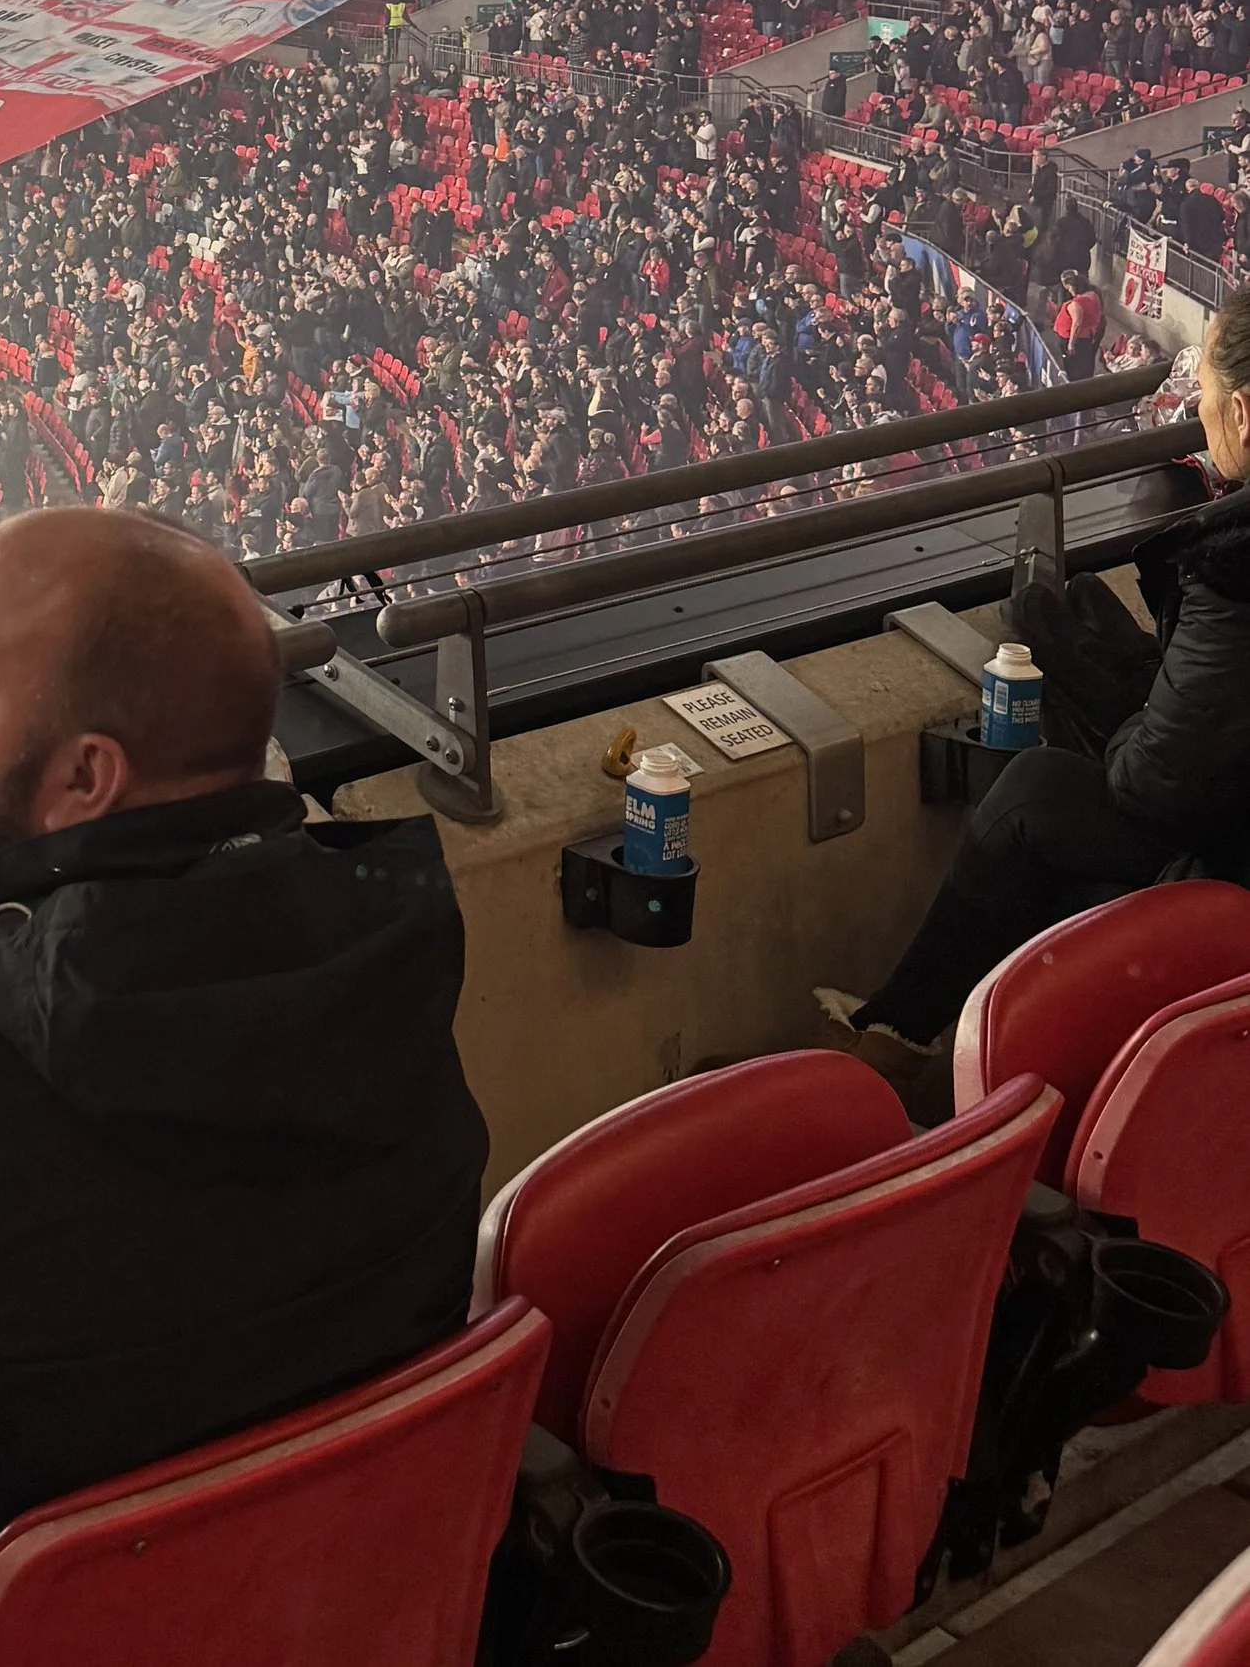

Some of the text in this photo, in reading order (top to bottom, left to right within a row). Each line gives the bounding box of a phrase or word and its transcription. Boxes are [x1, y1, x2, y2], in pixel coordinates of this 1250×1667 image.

[104, 52, 166, 75] CRYSTAL
[682, 692, 736, 714] PLEASE
[699, 707, 758, 731] REMAIN
[720, 724, 774, 747] SEATED
[625, 795, 656, 821] ELM
[625, 810, 656, 830] SPRING
